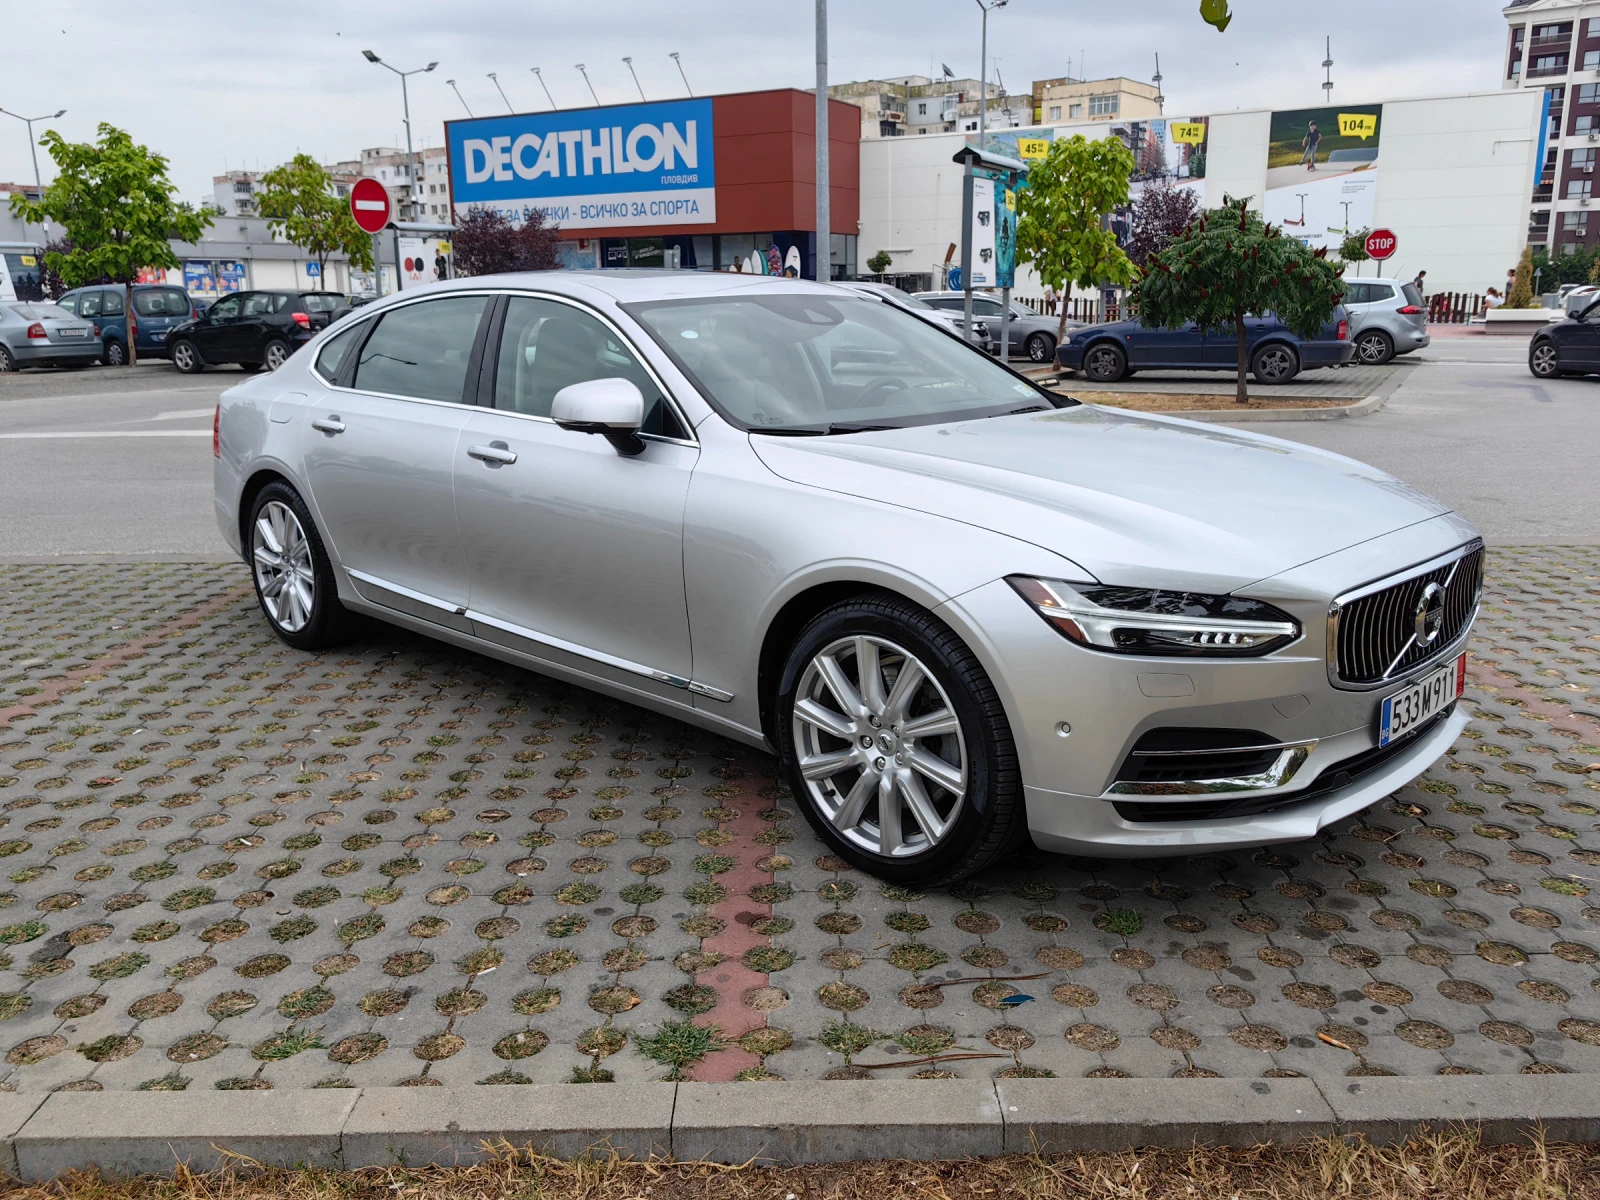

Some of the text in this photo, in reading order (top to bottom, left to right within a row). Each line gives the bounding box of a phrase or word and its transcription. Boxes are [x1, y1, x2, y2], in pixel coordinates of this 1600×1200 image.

[1342, 119, 1364, 131] 104
[1180, 127, 1192, 138] 74
[463, 119, 698, 184] DECATHLON
[1025, 143, 1037, 154] 45
[661, 174, 699, 185] ПЛОВДИВ
[507, 209, 520, 223] ЗА
[580, 202, 628, 219] ВСИЧКО
[631, 202, 647, 217] ЗА
[650, 199, 700, 216] СПОРТА
[1368, 237, 1394, 250] STOP
[1381, 727, 1389, 740] BG
